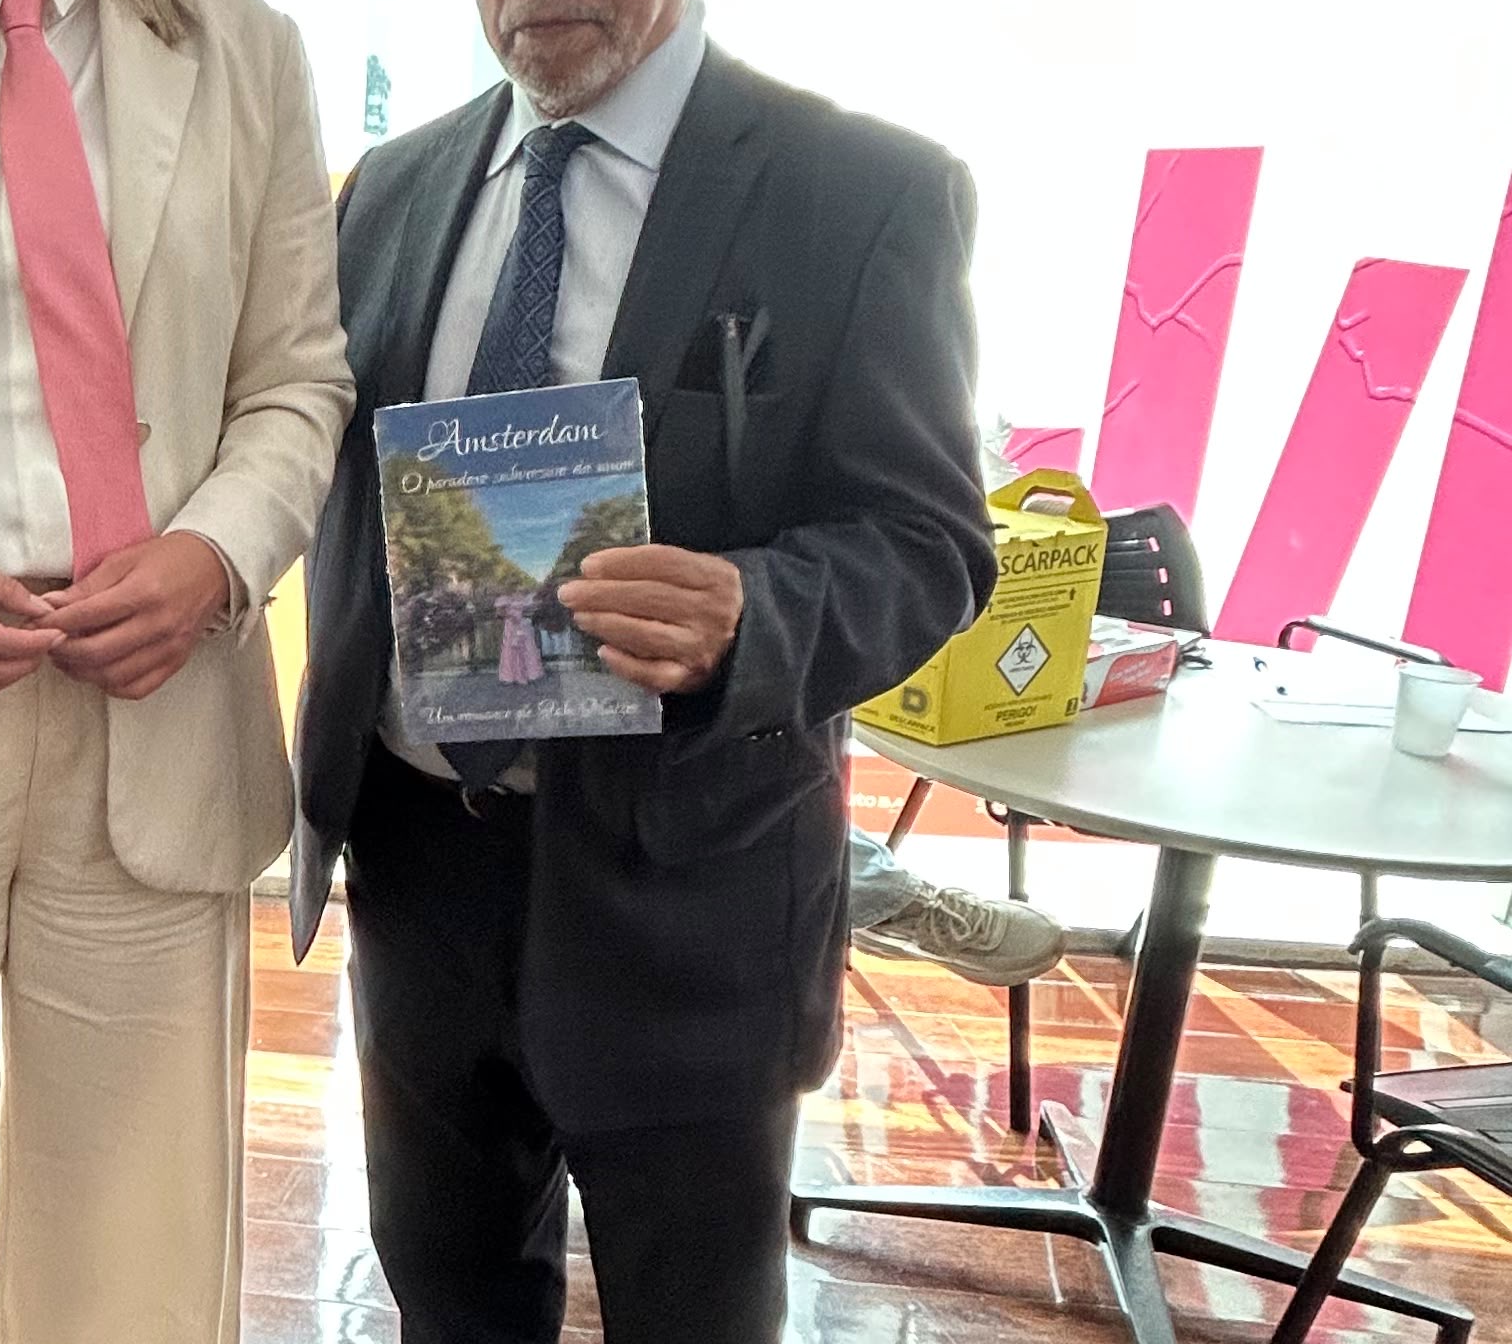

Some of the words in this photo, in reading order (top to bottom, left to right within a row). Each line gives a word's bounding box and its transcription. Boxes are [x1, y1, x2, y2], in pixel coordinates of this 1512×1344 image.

[418, 414, 602, 461] Amsterdam
[402, 471, 422, 493] O
[999, 543, 1099, 576] SCARPACK
